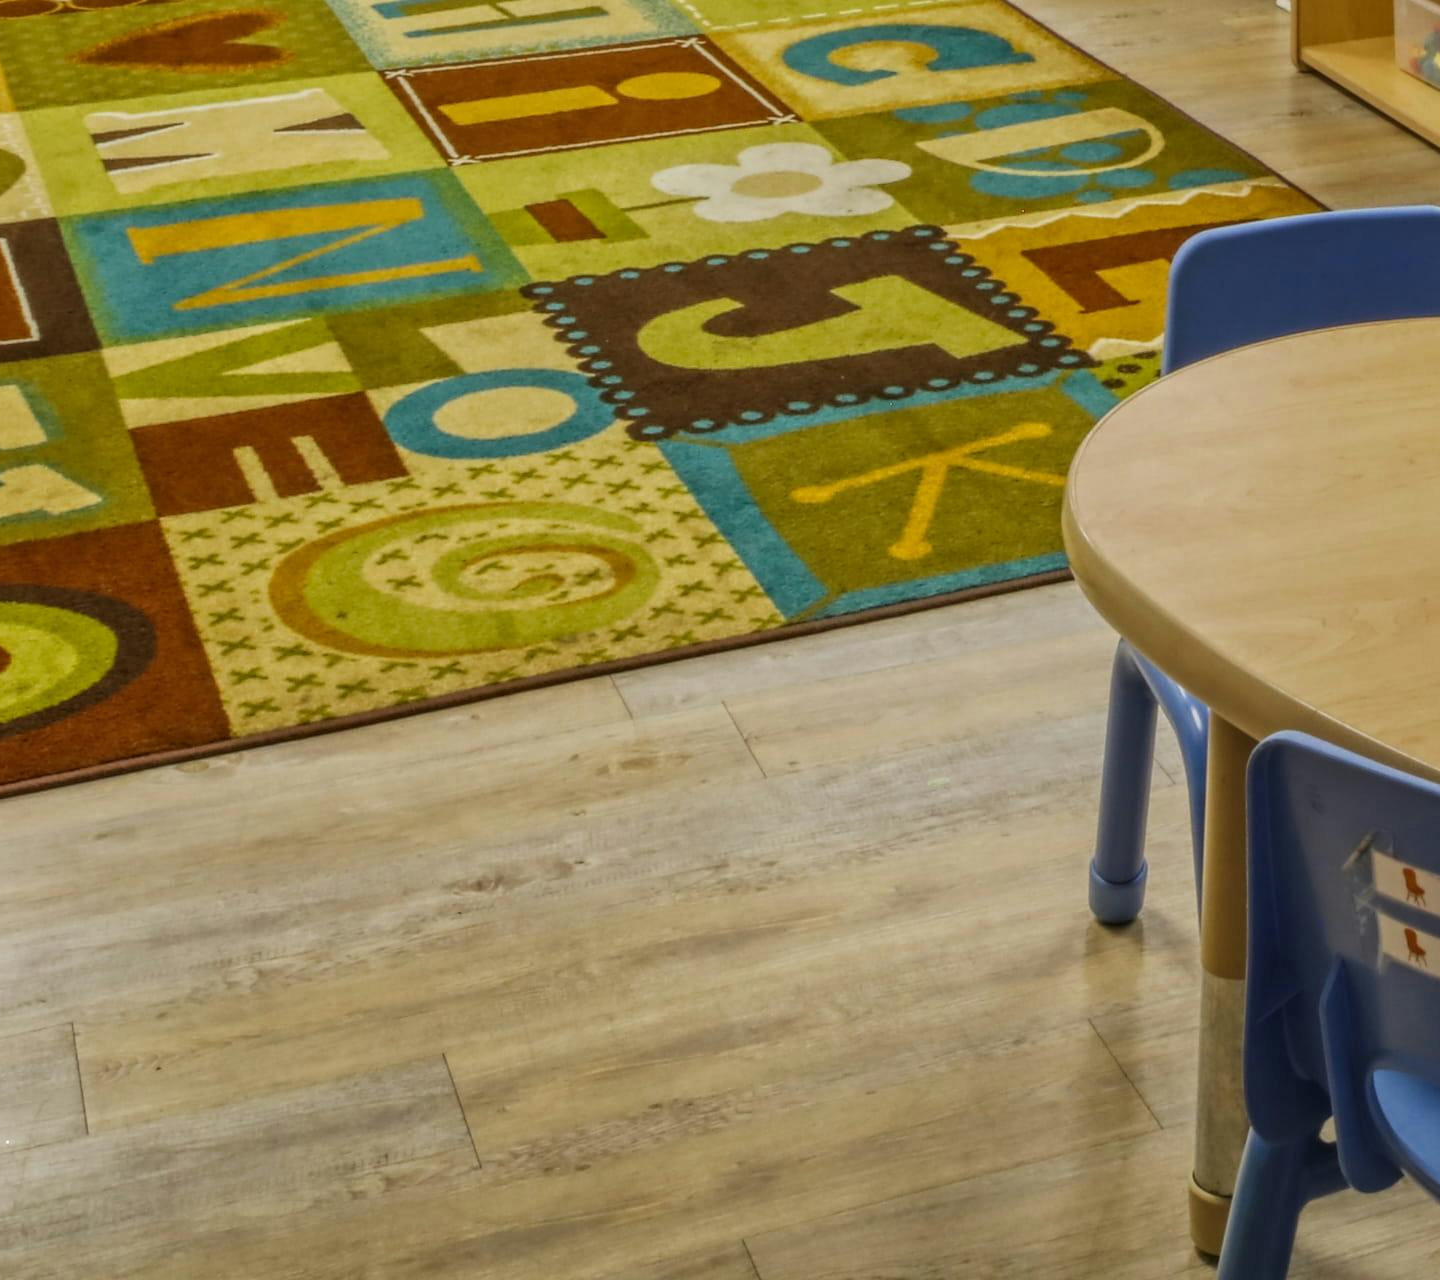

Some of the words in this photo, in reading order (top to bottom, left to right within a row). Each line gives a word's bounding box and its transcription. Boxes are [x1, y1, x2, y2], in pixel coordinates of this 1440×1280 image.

[782, 21, 1036, 88] C
[914, 105, 1165, 178] D
[126, 196, 484, 312] N
[636, 273, 1028, 373] J
[789, 421, 1066, 562] K
